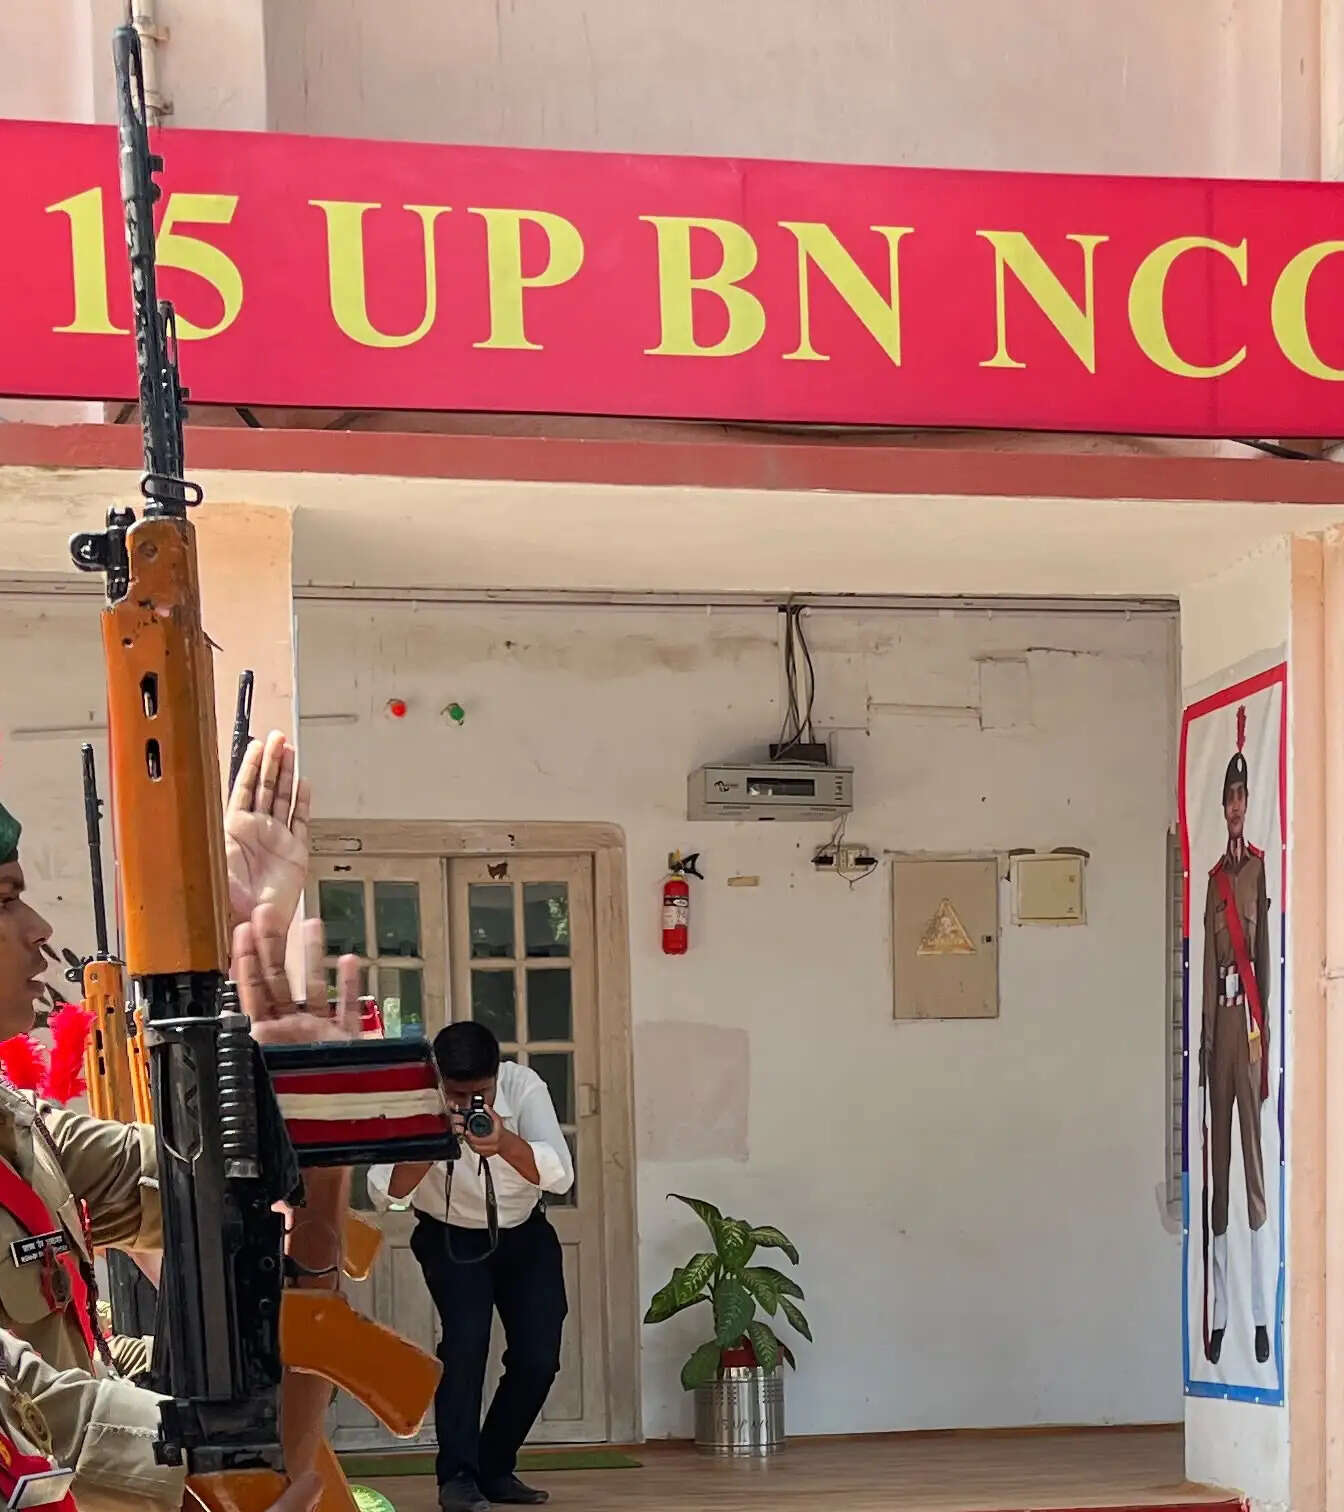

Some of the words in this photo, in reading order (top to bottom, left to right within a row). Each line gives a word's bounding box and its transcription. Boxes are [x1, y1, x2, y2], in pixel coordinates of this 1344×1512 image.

[46, 187, 243, 341] 15
[309, 198, 584, 350] UP
[646, 215, 913, 368] BN
